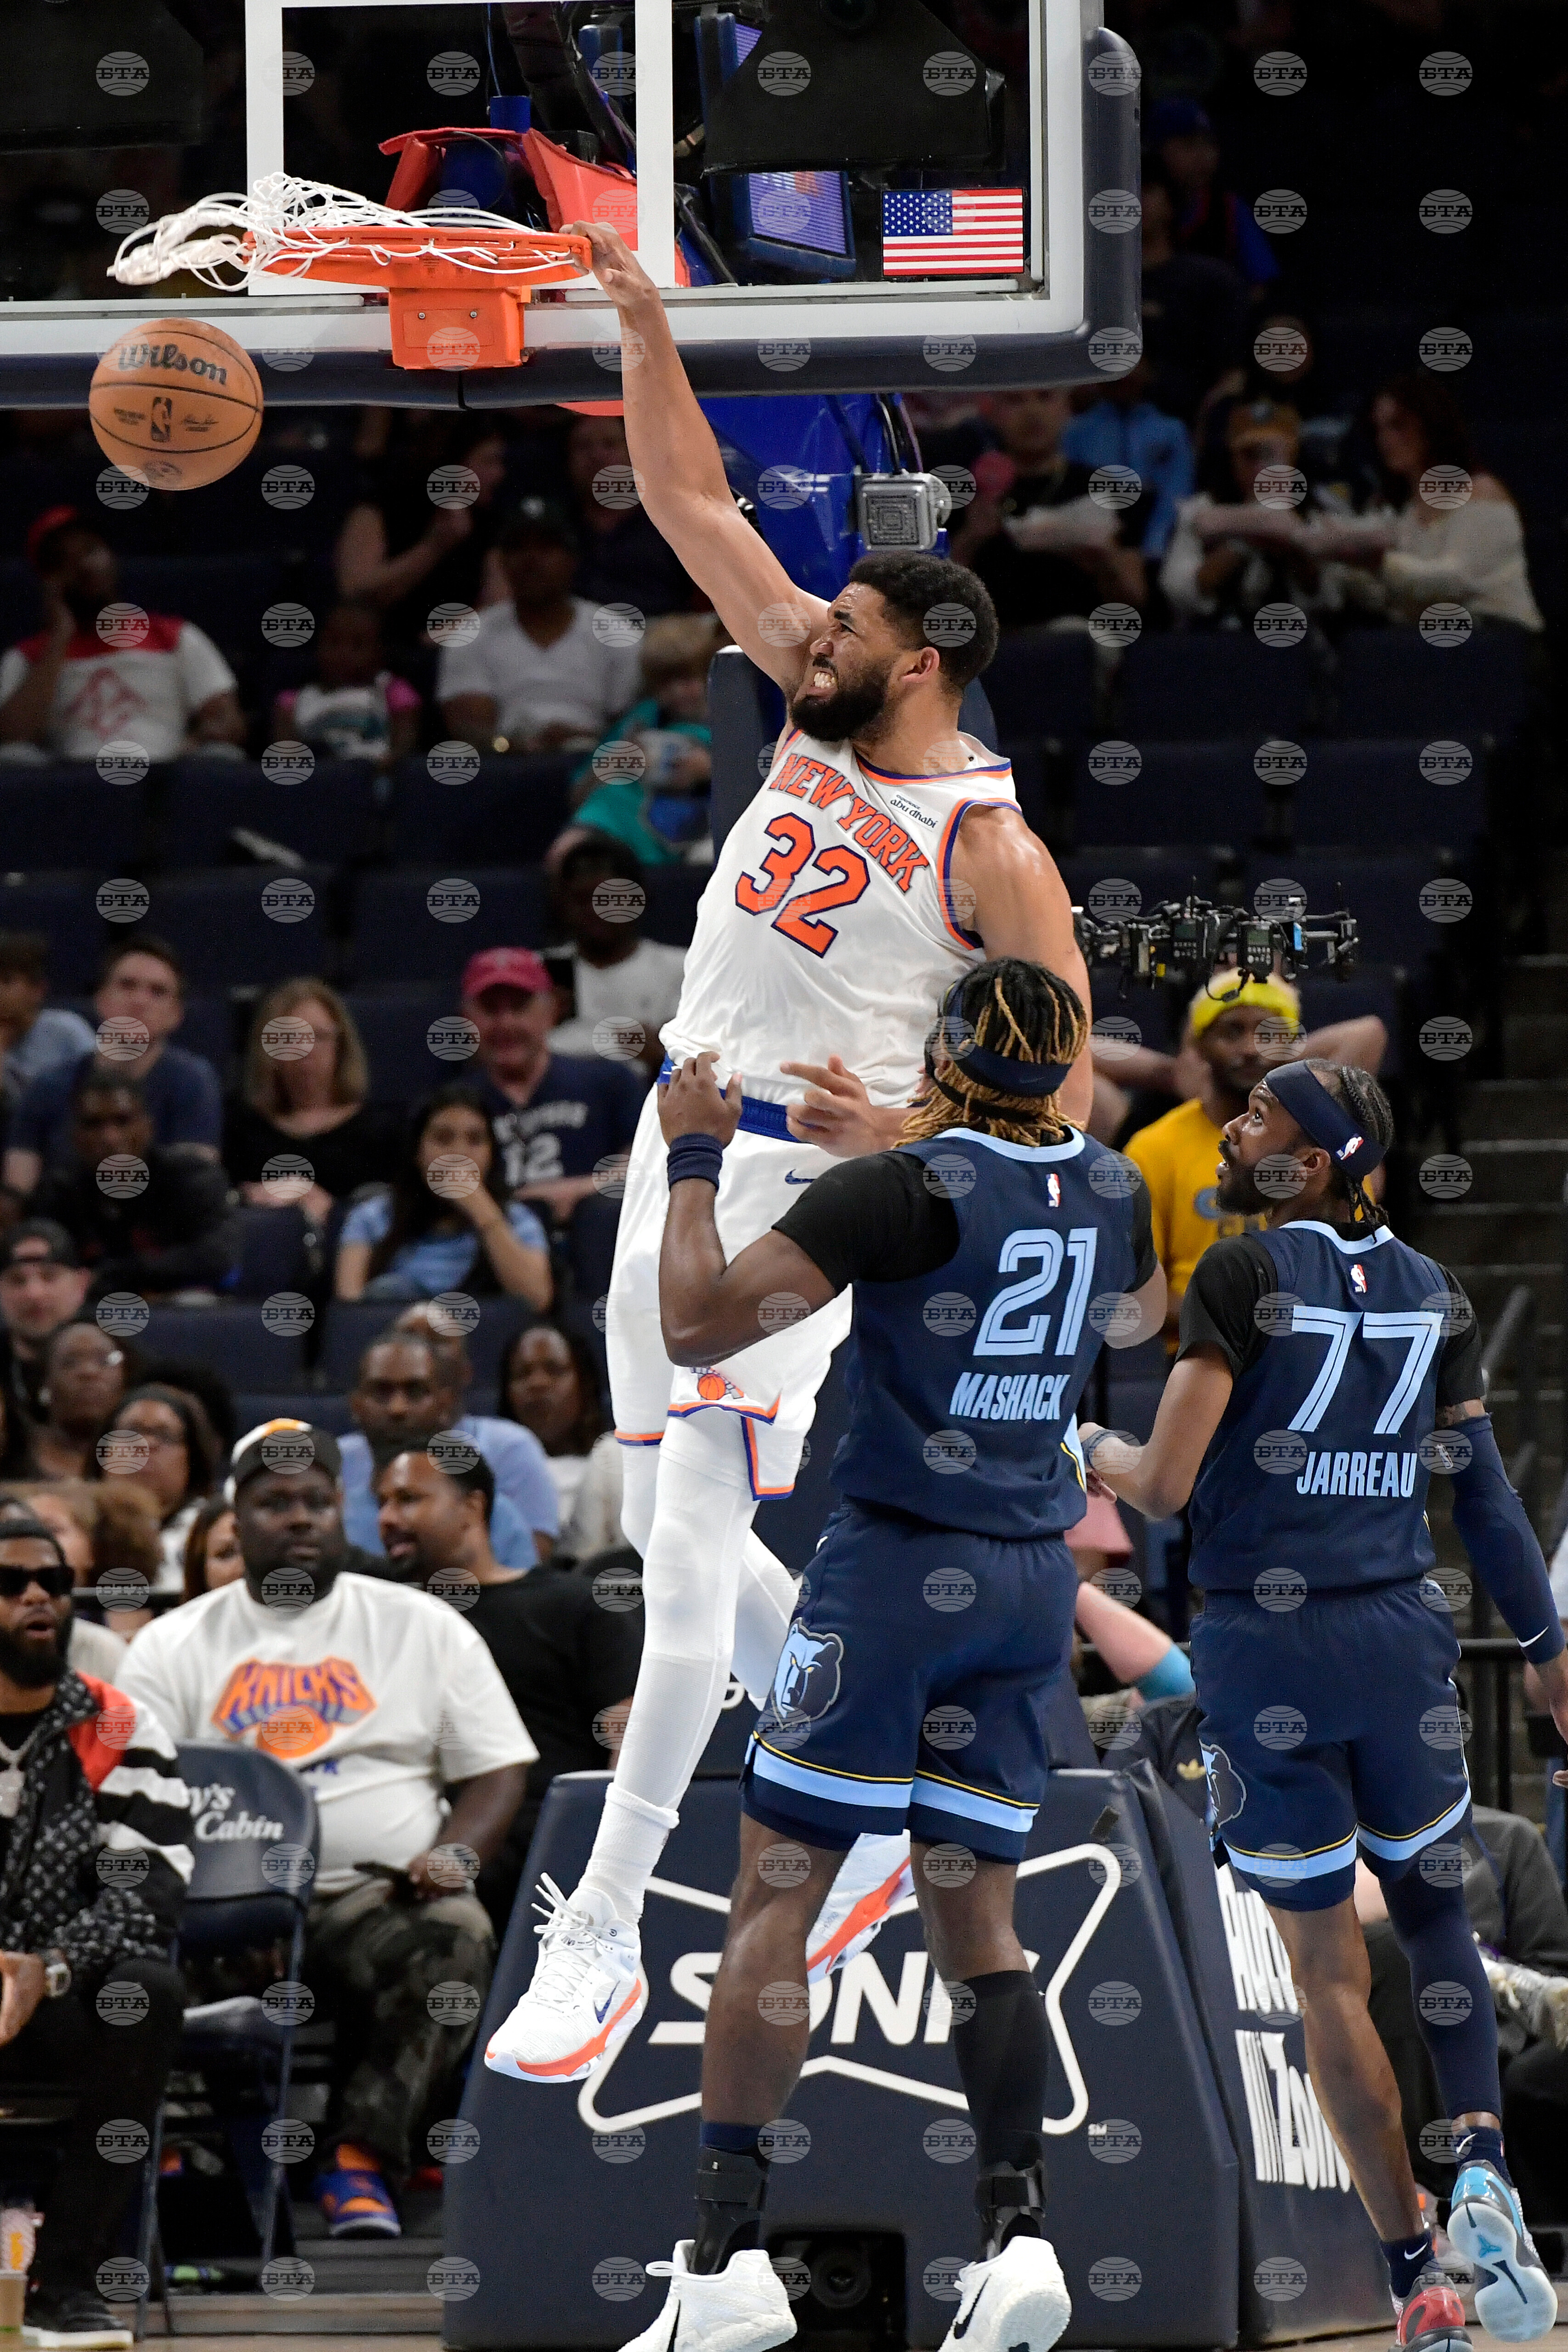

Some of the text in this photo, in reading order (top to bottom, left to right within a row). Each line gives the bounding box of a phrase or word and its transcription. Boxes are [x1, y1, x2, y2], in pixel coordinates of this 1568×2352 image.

[118, 344, 228, 385] Wilson
[767, 753, 931, 895] NEW YORK
[890, 799, 939, 828] abu dhabi
[735, 812, 870, 959] 32
[505, 1132, 564, 1187] 12
[973, 1227, 1098, 1356] 21
[949, 1372, 1071, 1420] MASHACK
[1287, 1305, 1444, 1434] 77
[1296, 1451, 1417, 1497] JARREAU
[214, 1658, 374, 1731] KNICKS
[195, 1810, 283, 1842] Cabin
